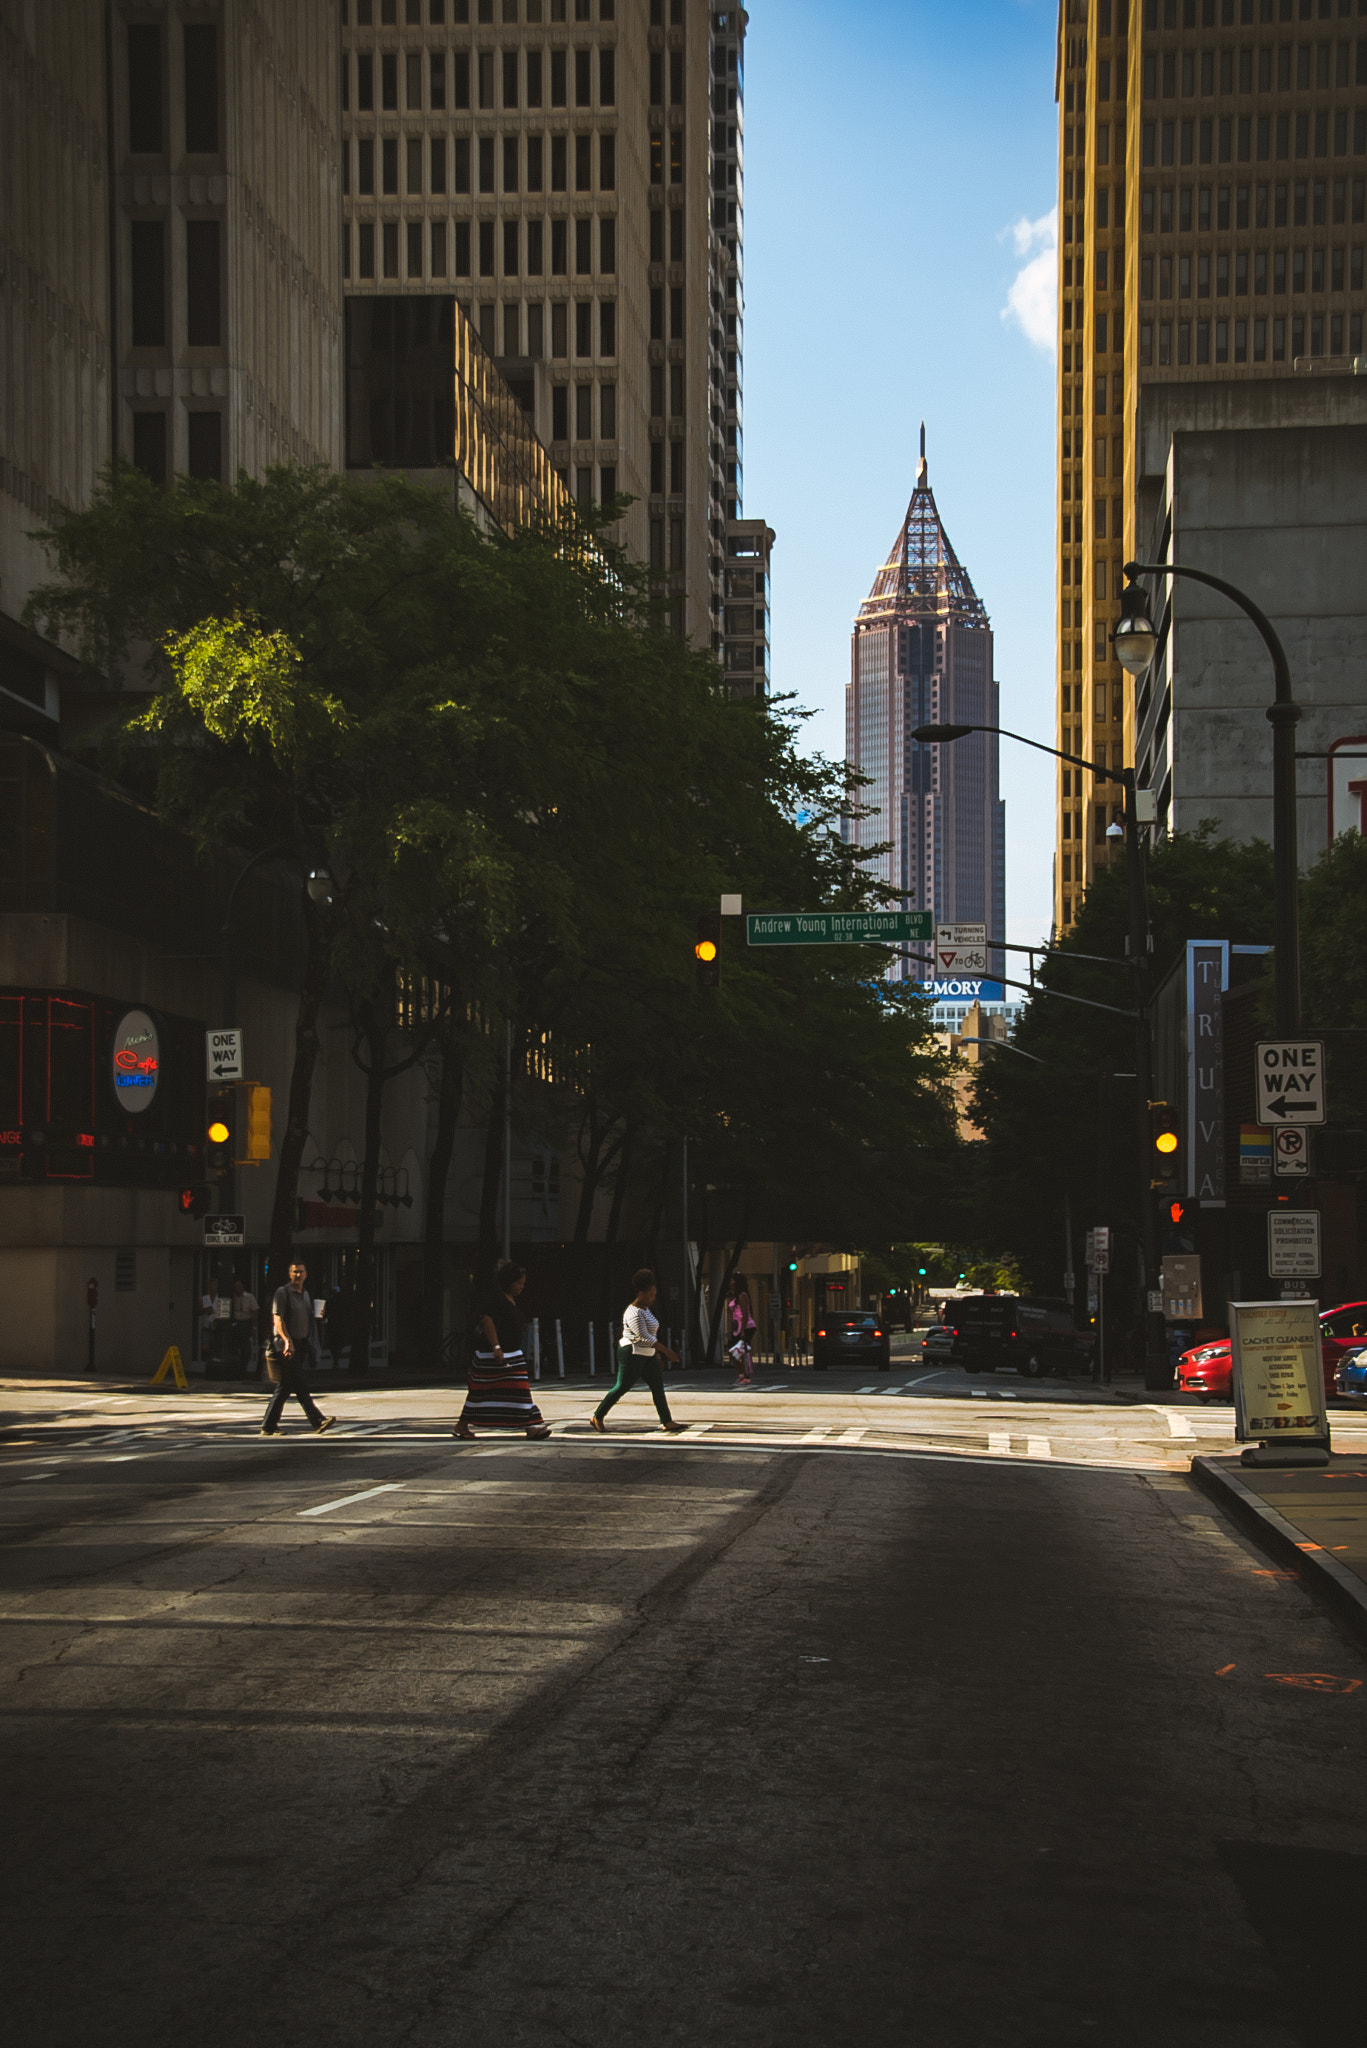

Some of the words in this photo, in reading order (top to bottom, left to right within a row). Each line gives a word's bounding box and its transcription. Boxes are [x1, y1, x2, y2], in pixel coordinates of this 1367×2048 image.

[754, 918, 791, 933] Andrew
[796, 916, 826, 936] Young
[831, 914, 898, 931] International
[905, 914, 923, 925] BLVD
[954, 926, 984, 934] TURNING
[910, 928, 919, 938] NE
[954, 935, 985, 943] VEHICLES
[923, 980, 982, 996] EMORY
[1213, 961, 1222, 1069] TURKISH
[213, 1034, 236, 1047] ONE
[212, 1049, 237, 1062] WAY
[1264, 1048, 1317, 1068] ONE
[1197, 960, 1215, 1197] TRUVA
[1264, 1073, 1317, 1093] WAY
[1241, 1156, 1271, 1165] marta
[1273, 1217, 1314, 1226] COMMERCIAL
[206, 1235, 222, 1244] BIKE
[223, 1235, 243, 1244] LANE
[1275, 1237, 1313, 1245] PROHIBITED
[1284, 1281, 1307, 1290] BUS
[1242, 1336, 1274, 1345] CACHET
[1276, 1335, 1314, 1344] CLEANERS
